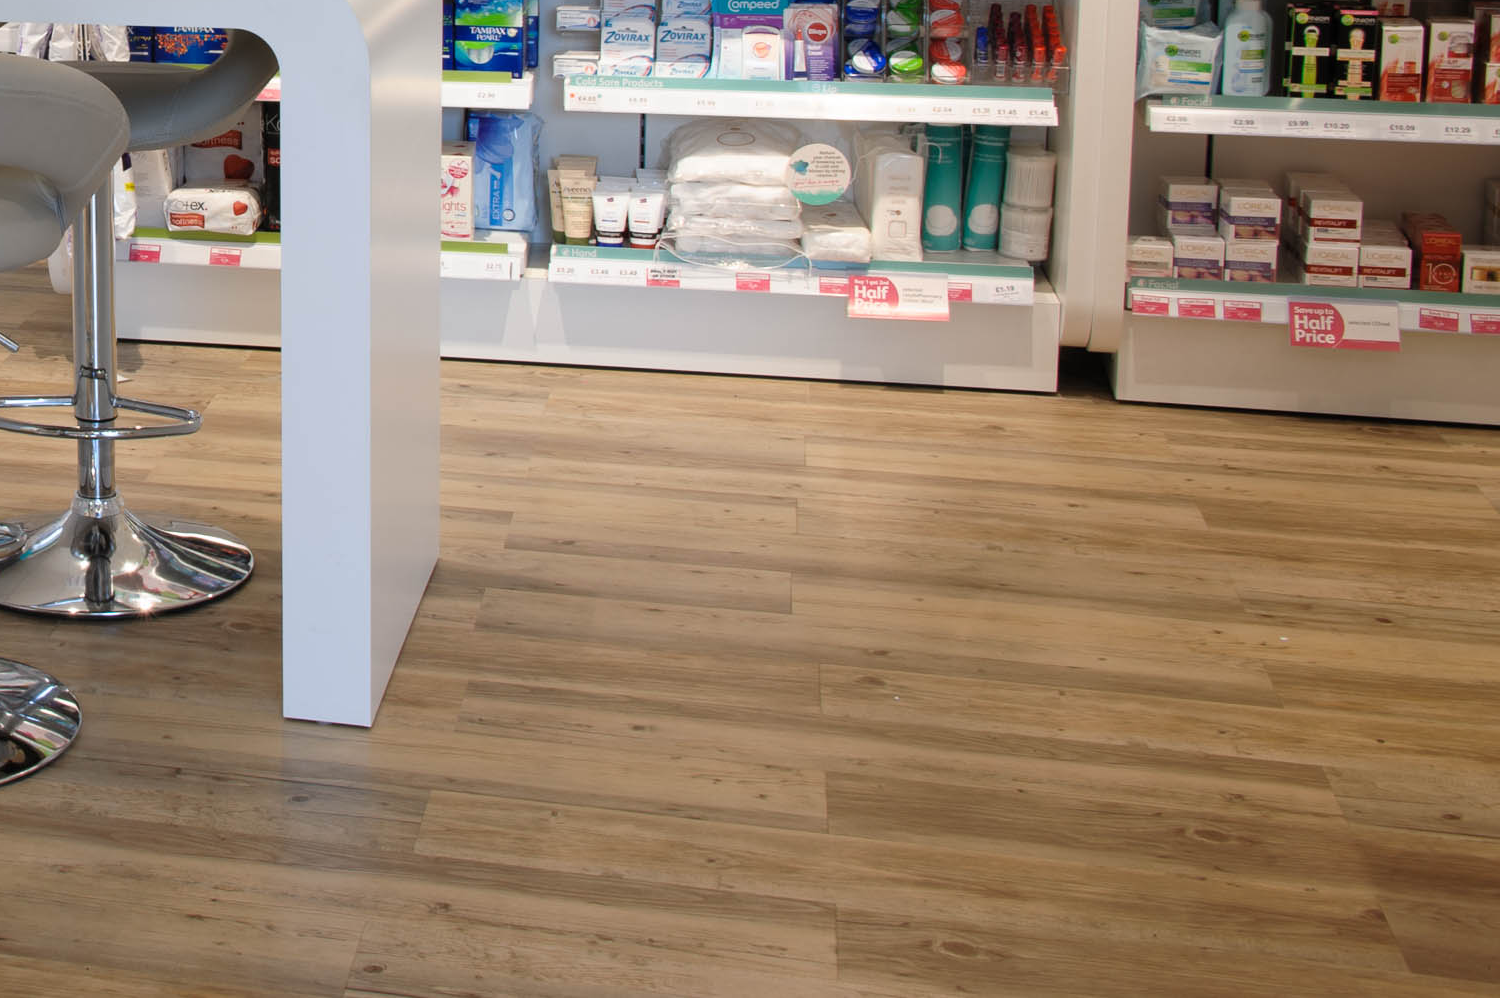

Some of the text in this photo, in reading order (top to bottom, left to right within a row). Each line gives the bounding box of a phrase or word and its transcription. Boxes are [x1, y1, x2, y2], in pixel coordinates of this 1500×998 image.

[469, 26, 507, 36] TAMPAX
[659, 29, 706, 42] ZOVIRAX
[476, 34, 500, 42] PEARL
[604, 31, 650, 44] ZOVIRAX
[1181, 96, 1212, 107] Facial
[563, 186, 591, 195] Aveeno
[441, 201, 467, 214] ights
[492, 190, 500, 220] EXTRA
[571, 248, 597, 258] Hand
[1148, 278, 1179, 289] Facial
[854, 285, 889, 299] Half
[1294, 306, 1313, 314] Save
[1325, 307, 1334, 315] to
[1294, 314, 1334, 330] Half
[1294, 329, 1335, 344] Price
